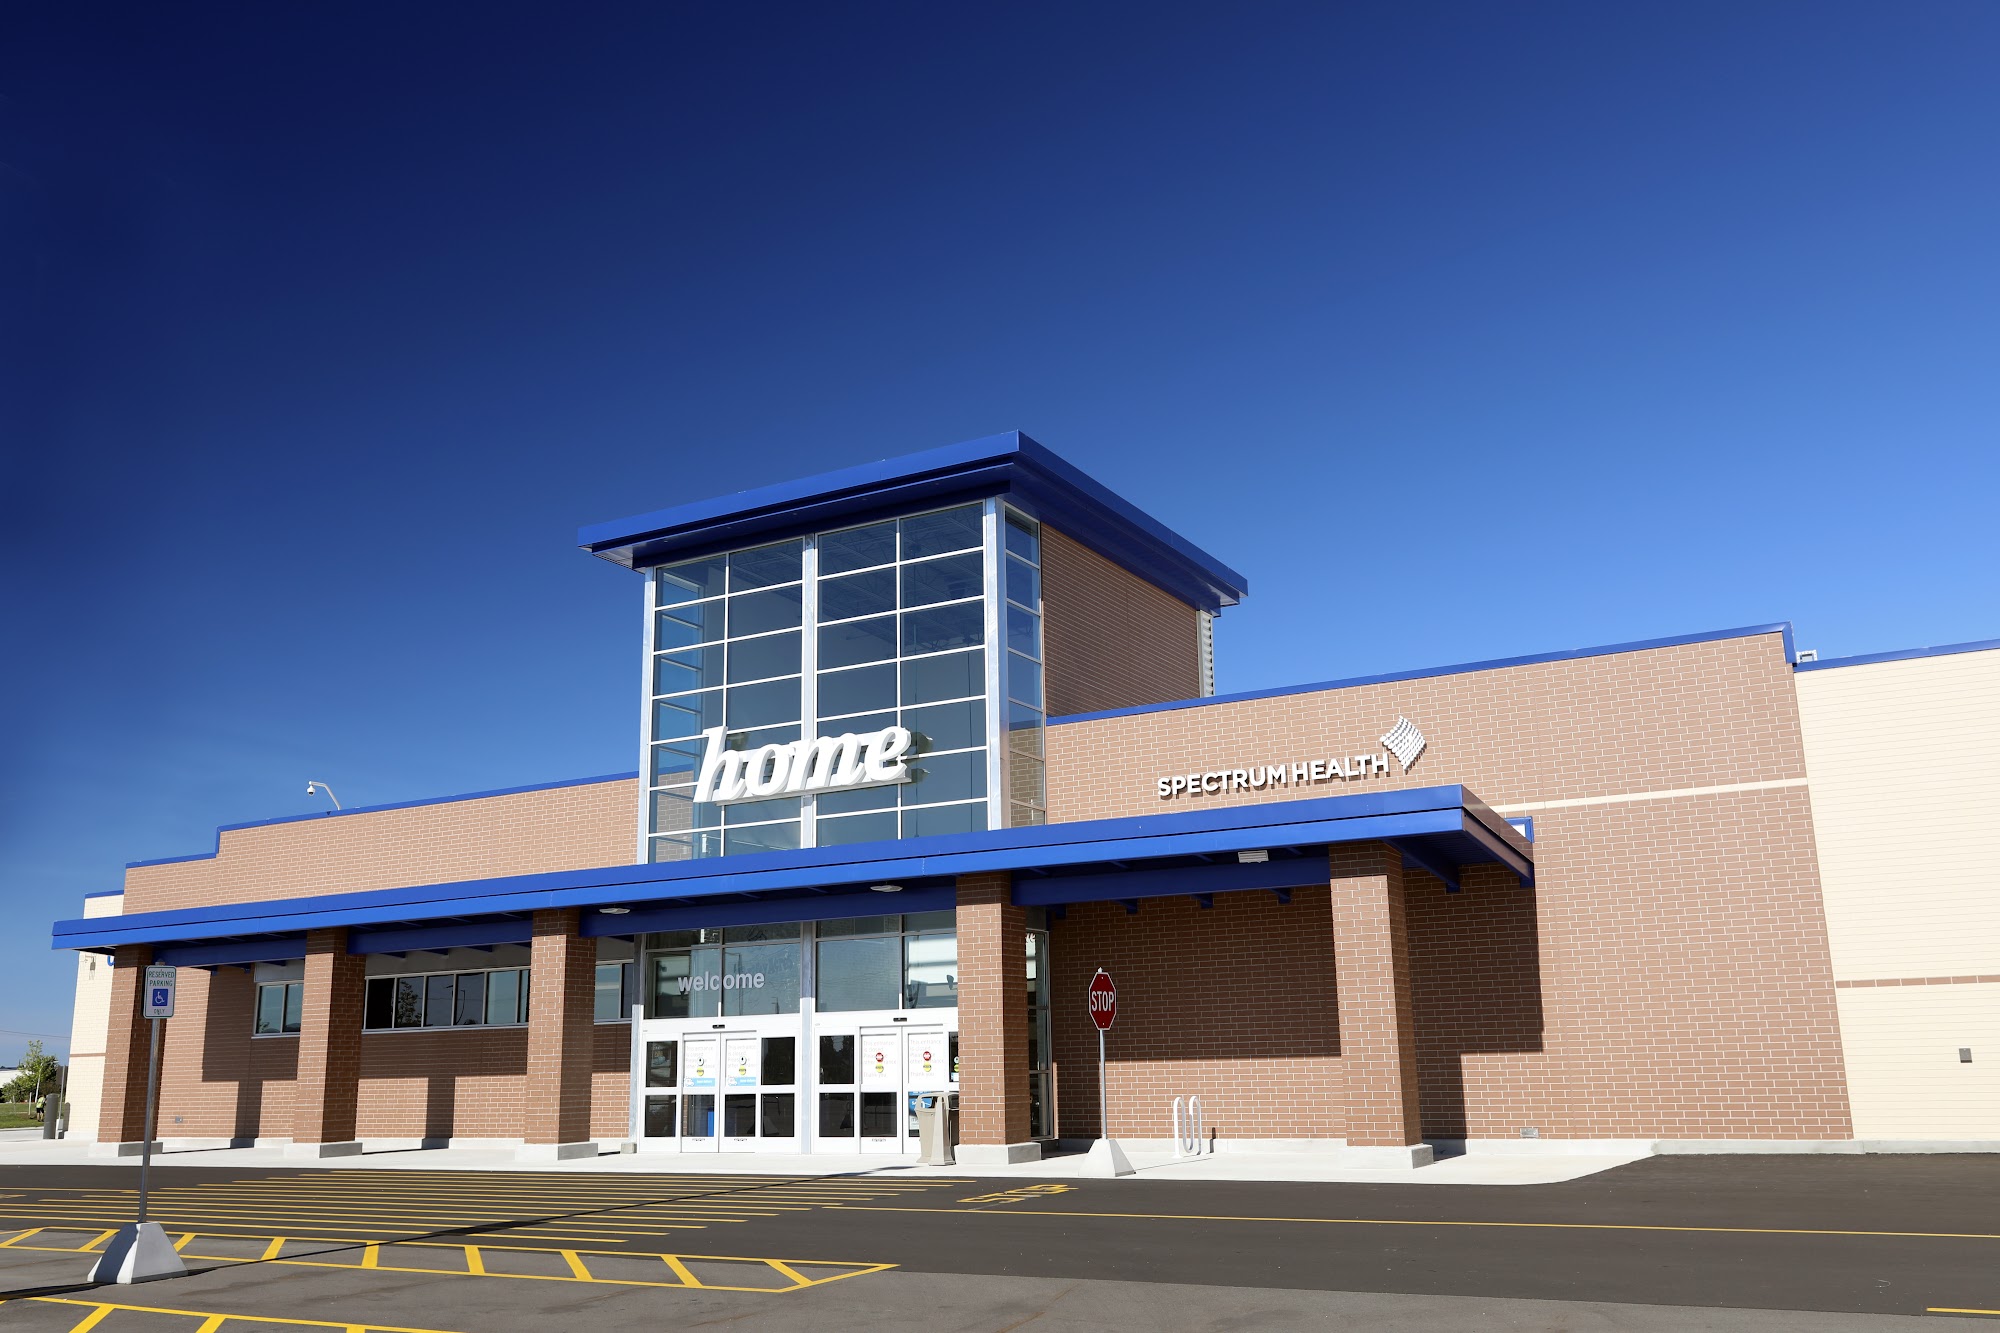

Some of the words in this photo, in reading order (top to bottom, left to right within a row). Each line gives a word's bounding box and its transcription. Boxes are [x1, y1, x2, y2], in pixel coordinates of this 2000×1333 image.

[693, 726, 911, 802] home
[1157, 764, 1287, 797] SPECTRUM
[1292, 753, 1390, 782] HEALTH
[677, 971, 765, 992] welcome
[1091, 991, 1115, 1012] STOP
